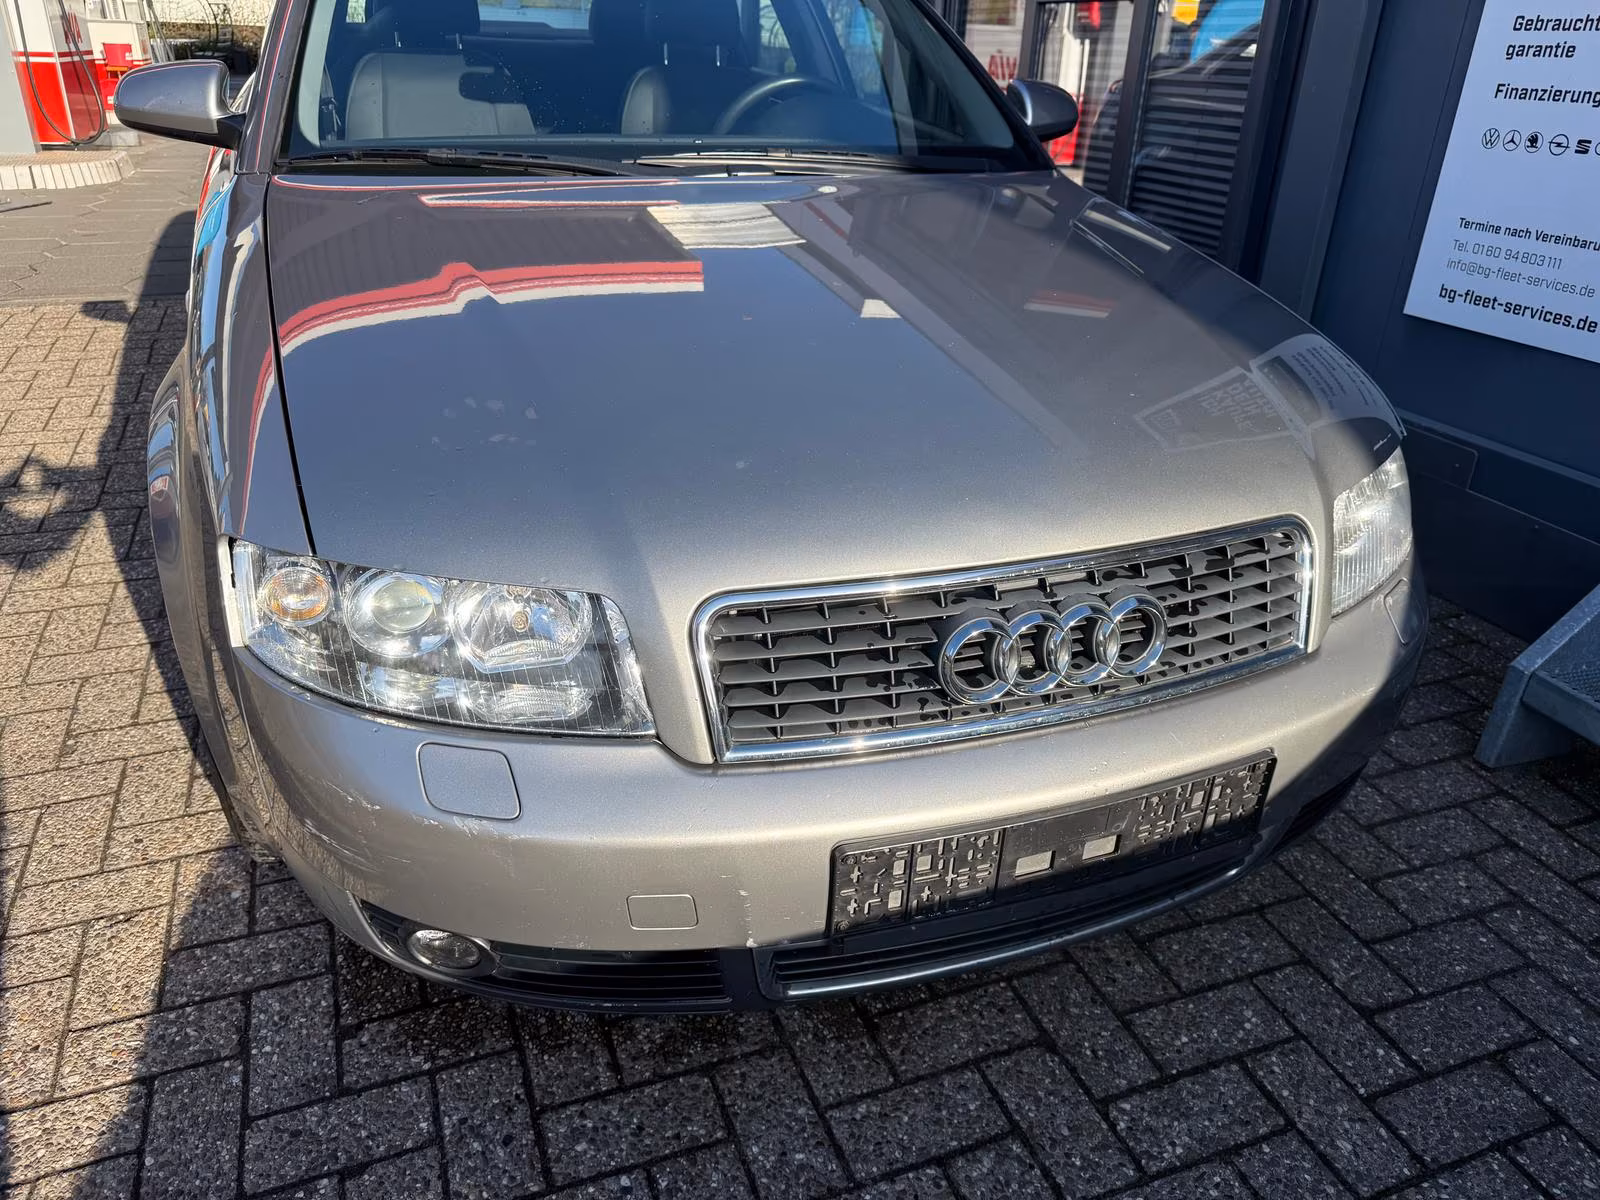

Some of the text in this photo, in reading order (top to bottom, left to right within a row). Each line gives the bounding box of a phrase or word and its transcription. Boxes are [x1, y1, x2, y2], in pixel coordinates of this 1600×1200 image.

[1505, 41, 1576, 60] garantie
[1494, 83, 1600, 108] Finanzierung
[1458, 217, 1502, 234] Termine
[1504, 226, 1532, 240] nach
[1453, 239, 1469, 252] Tel.
[1472, 243, 1501, 259] 0160
[1447, 258, 1596, 298] info@bg-fleet-services.de
[1439, 283, 1598, 333] bg-fleet-services.de
